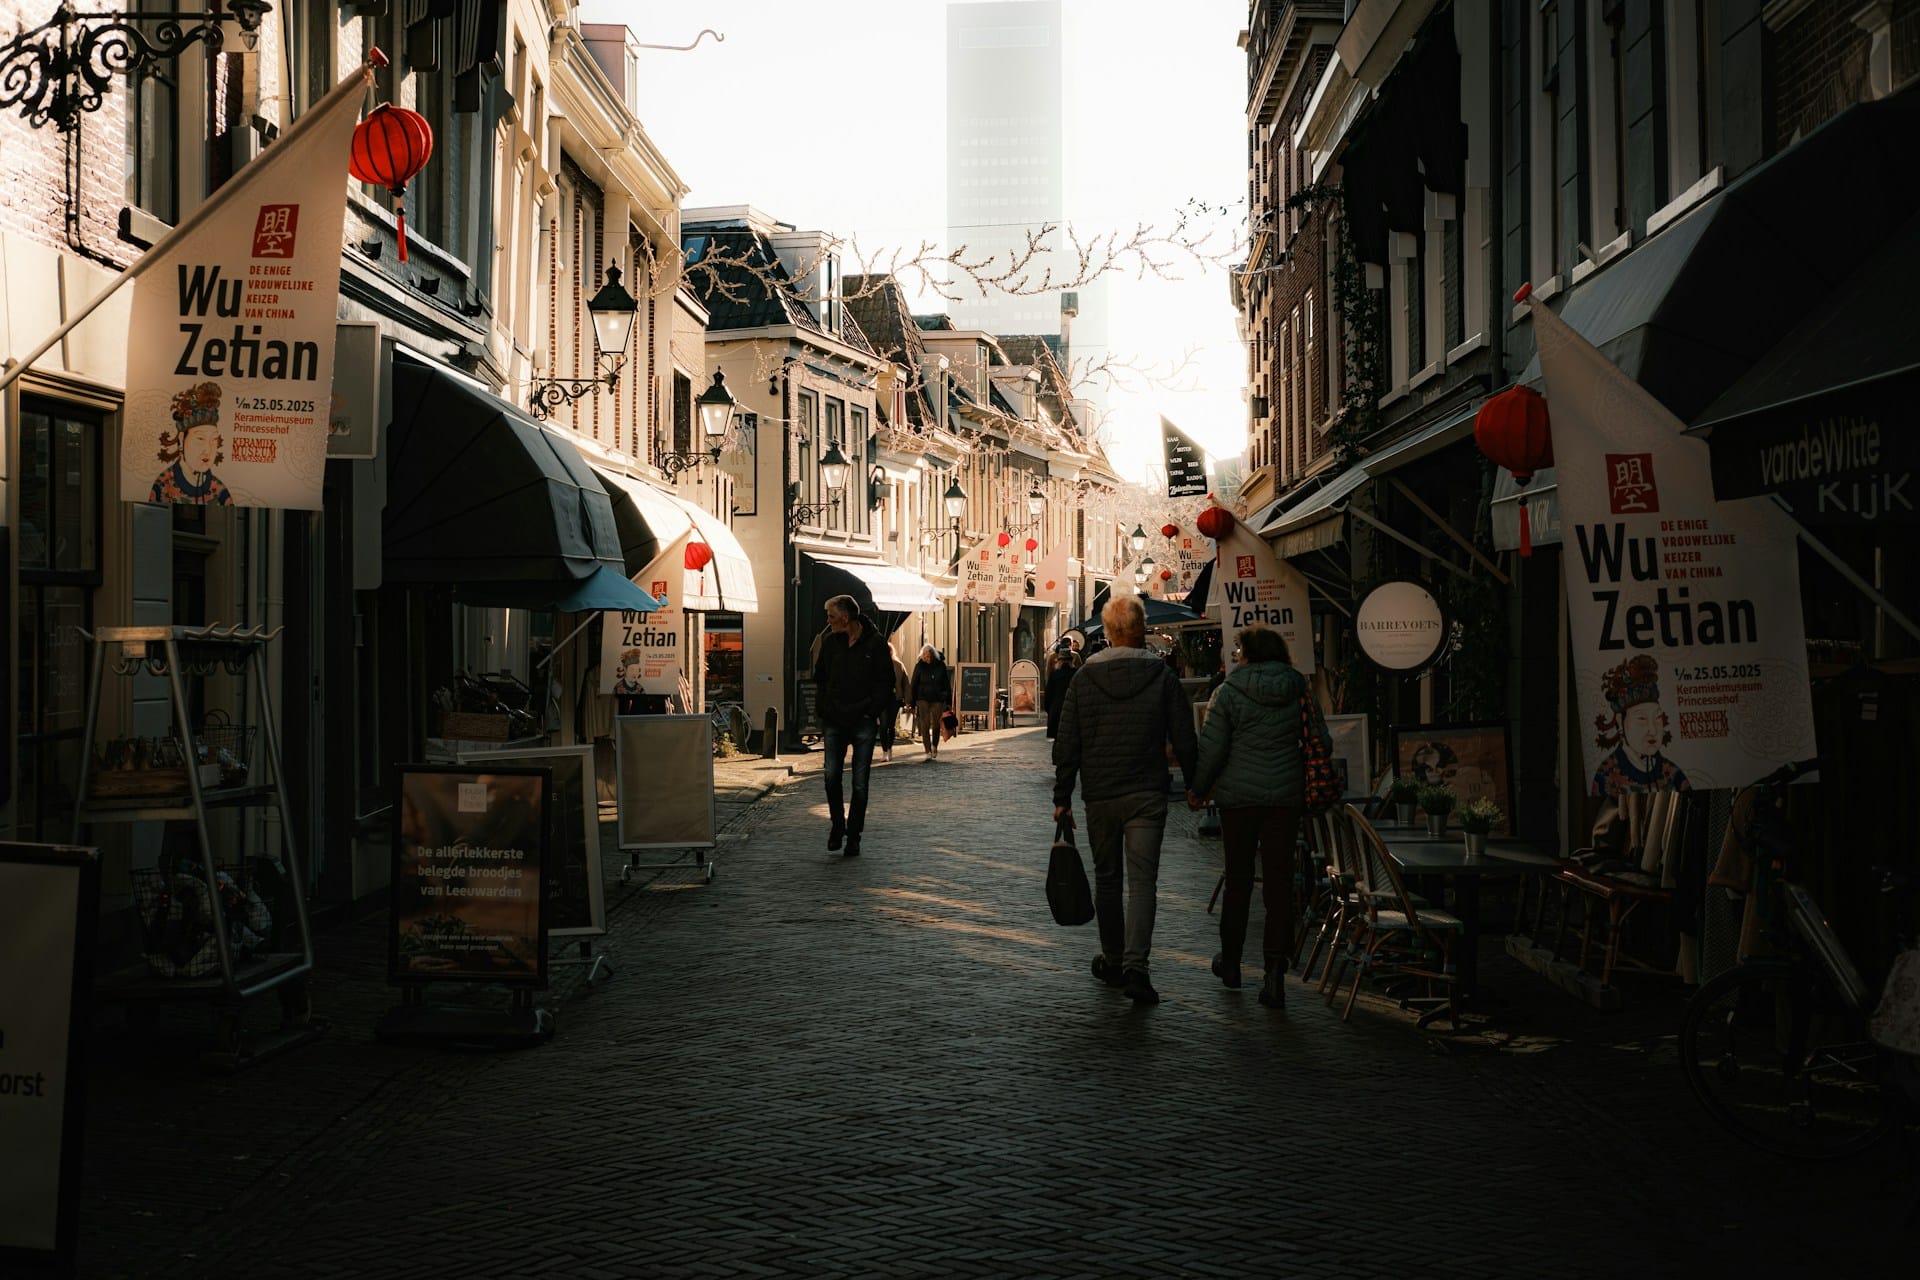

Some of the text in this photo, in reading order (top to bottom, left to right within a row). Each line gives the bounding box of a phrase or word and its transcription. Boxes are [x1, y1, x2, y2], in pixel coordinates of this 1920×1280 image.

[249, 265, 292, 275] DE ENIGE
[178, 264, 243, 318] Wu
[248, 279, 314, 291] VROUWELIJKE
[246, 294, 279, 304] KEIZER
[245, 308, 295, 319] VAN CHINA
[174, 323, 318, 380] Zetian
[252, 398, 315, 413] 25.05.2025
[233, 412, 314, 425] Keramiekmuseum
[233, 422, 290, 434] Princessehof
[1660, 519, 1708, 532] DE ENIGE
[1662, 534, 1736, 547] VROUWELIJKE
[1178, 550, 1192, 560] Wu
[1575, 523, 1659, 583] Wu
[1664, 551, 1702, 563] KEIZER
[966, 560, 980, 570] Wu
[998, 564, 1010, 574] Wu
[968, 570, 994, 582] Zetian
[999, 574, 1022, 584] Zetian
[1665, 566, 1723, 580] VAN CHINA
[1224, 582, 1256, 604] Wu
[1231, 604, 1294, 628] Zetian
[1592, 587, 1757, 650] Zetian
[1360, 620, 1440, 630] BARREVOETS
[622, 626, 676, 647] Zetian
[1694, 664, 1762, 680] 25.05.2025
[1677, 682, 1763, 695] Keramiekmuseum
[1678, 693, 1739, 706] Princessehof
[417, 846, 525, 860] De allerlekkerste
[417, 864, 523, 880] belegde broodjes
[420, 885, 522, 897] van Leeuwarden
